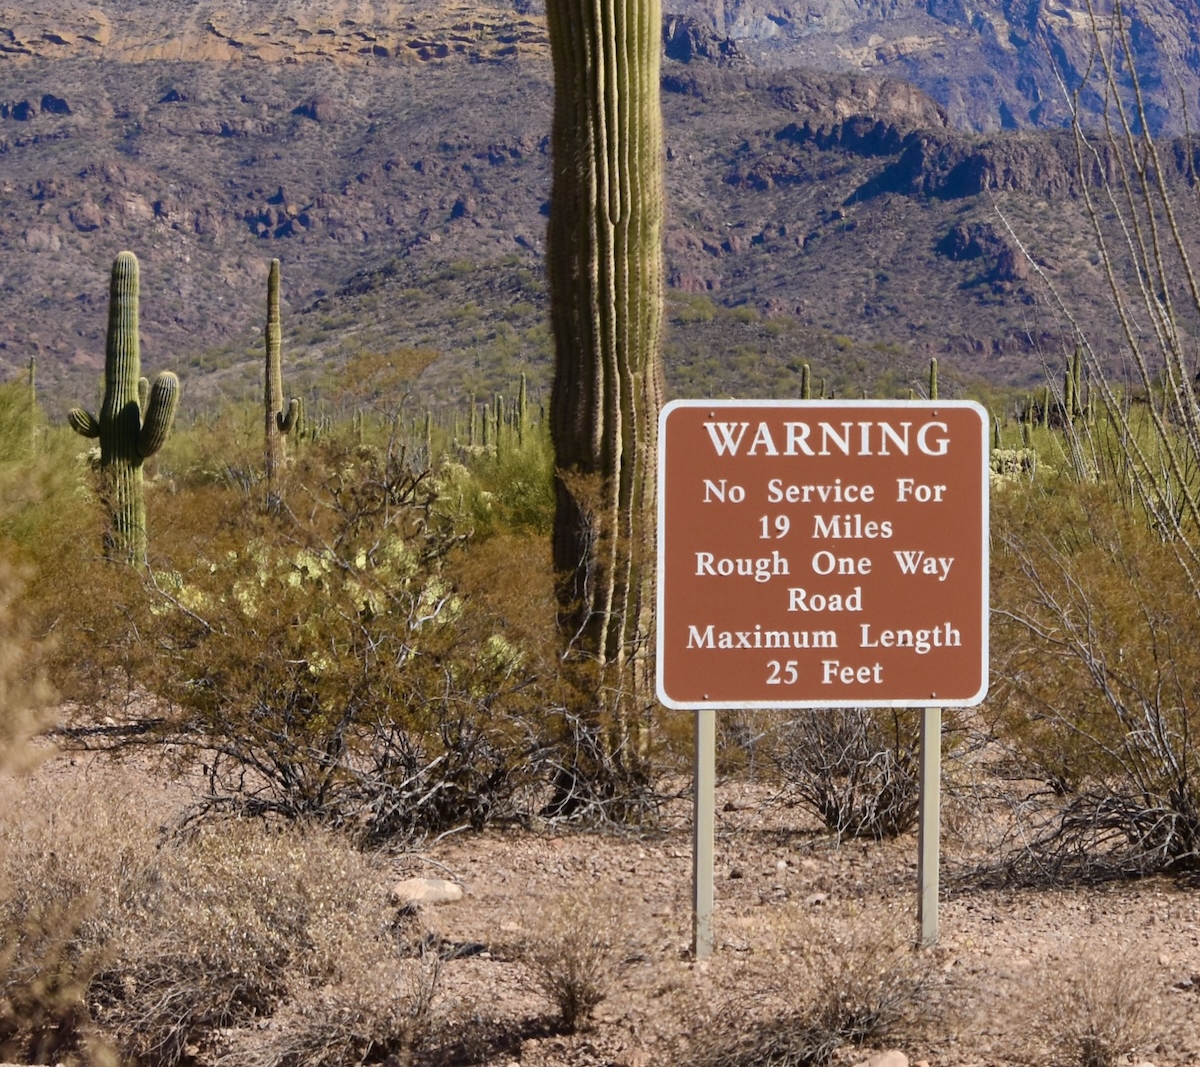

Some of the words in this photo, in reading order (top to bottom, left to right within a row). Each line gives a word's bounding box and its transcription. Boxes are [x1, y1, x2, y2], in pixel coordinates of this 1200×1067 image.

[702, 420, 951, 457] WARNING
[702, 479, 746, 504] No
[767, 478, 875, 504] Service
[896, 478, 947, 503] For
[759, 514, 791, 540] 19
[811, 513, 893, 539] Miles
[694, 550, 791, 583] Rough
[811, 550, 872, 576] One
[892, 550, 955, 582] Way
[787, 585, 864, 612] Road
[685, 624, 839, 650] Maximum
[859, 621, 962, 655] Length
[765, 659, 799, 685] 25
[821, 659, 884, 685] Feet
